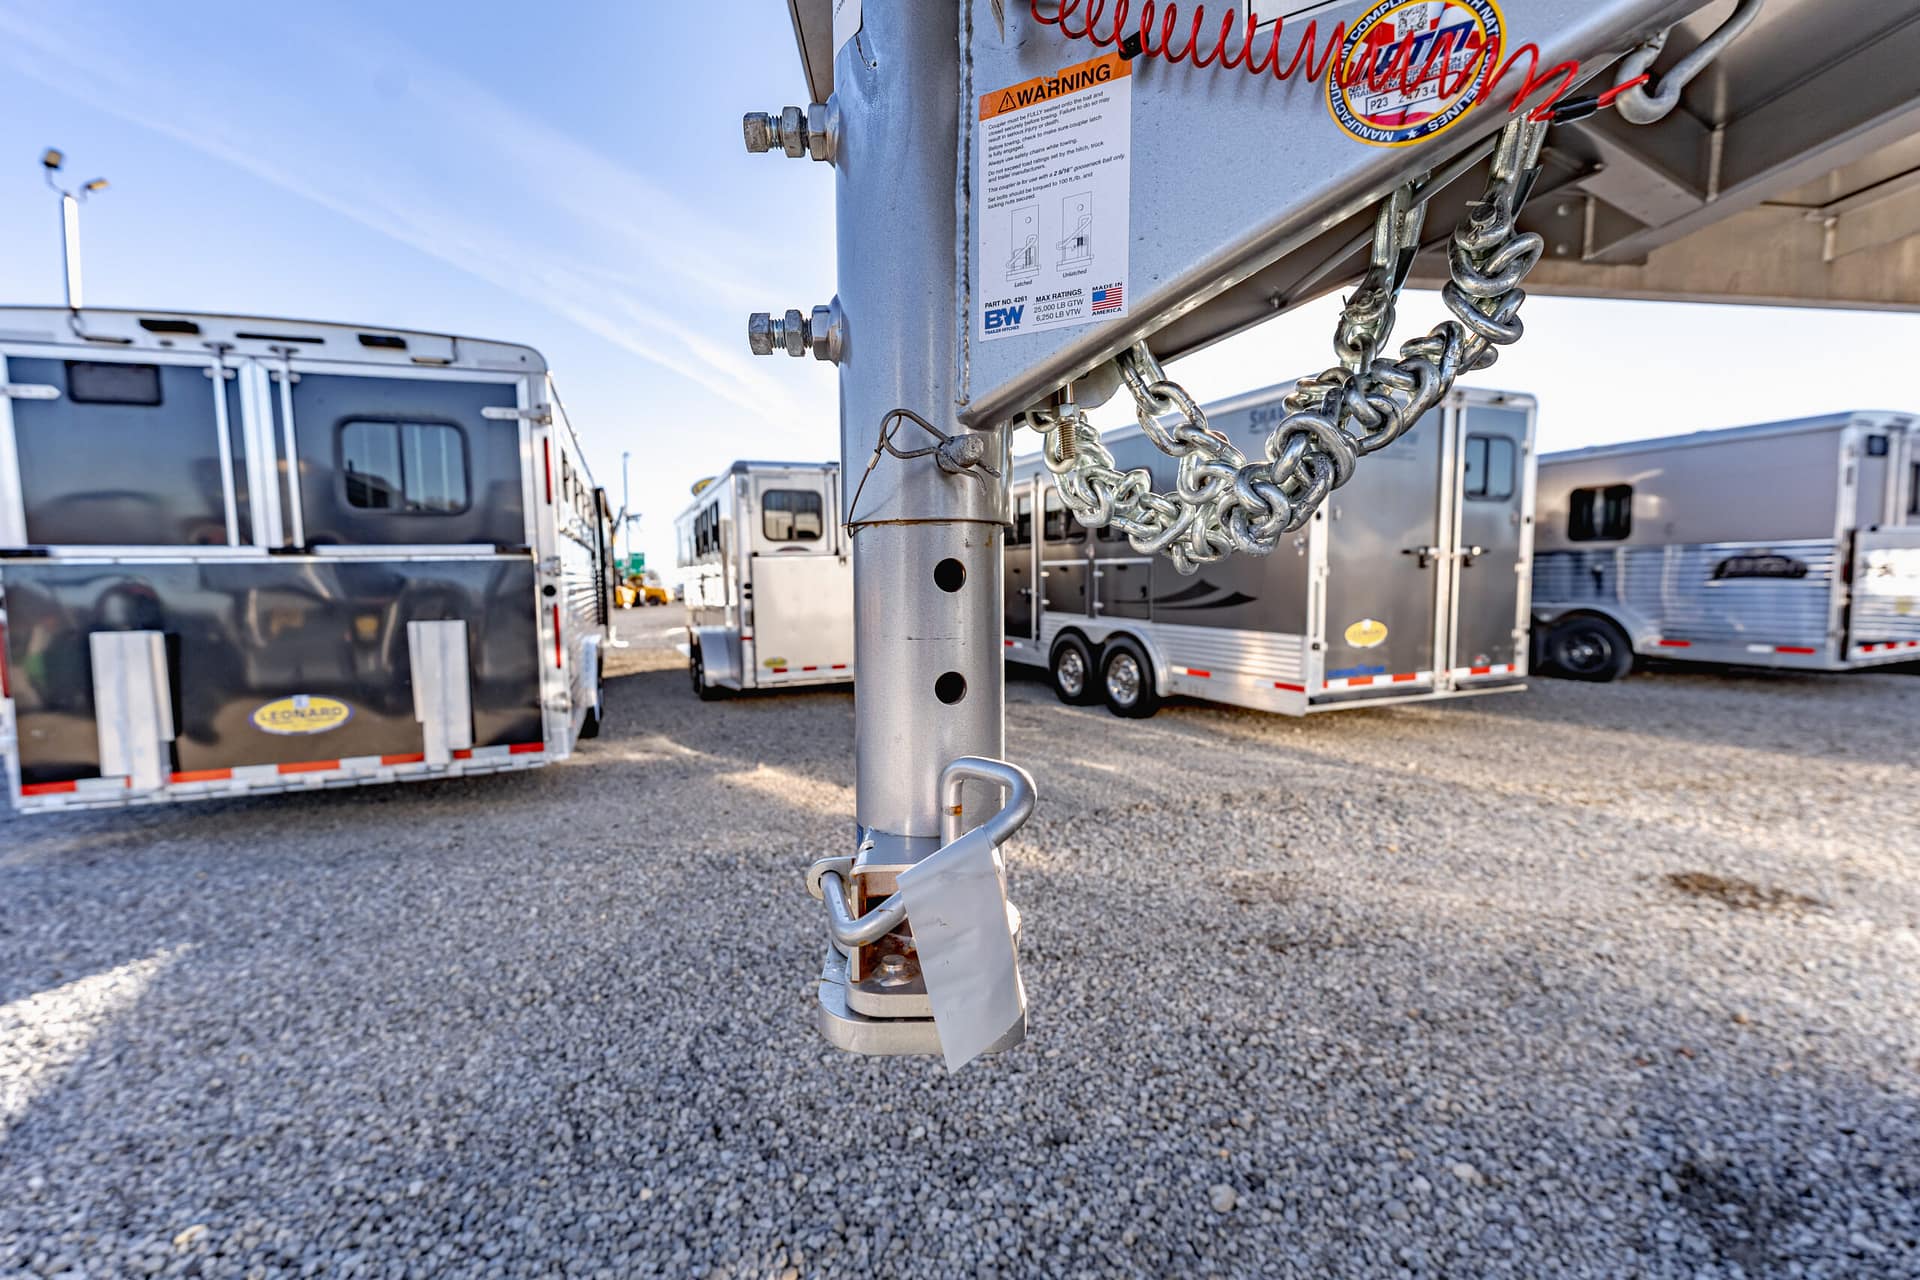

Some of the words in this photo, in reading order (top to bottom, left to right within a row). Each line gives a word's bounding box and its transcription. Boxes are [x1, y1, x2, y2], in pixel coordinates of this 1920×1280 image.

[1016, 63, 1112, 107] WARNING
[988, 121, 1006, 130] Coupler
[1026, 110, 1042, 119] FULLY
[1043, 104, 1060, 113] seated
[1061, 100, 1073, 108] onto
[1073, 97, 1082, 105] the
[1082, 94, 1092, 102] ball
[1093, 90, 1103, 98] and
[1370, 96, 1388, 110] P23
[988, 127, 1003, 136] closed
[1004, 122, 1024, 132] securely
[1024, 117, 1040, 127] before
[1059, 106, 1076, 116] Failure
[1083, 101, 1091, 109] do
[1091, 99, 1098, 107] so
[1098, 97, 1110, 105] may
[988, 143, 1004, 152] Before
[1022, 134, 1036, 142] check
[1042, 128, 1057, 136] make
[1058, 124, 1069, 132] sure
[1070, 118, 1089, 129] coupler
[1089, 114, 1102, 123] latch
[988, 135, 1001, 143] result
[1007, 129, 1024, 139] serious
[1024, 125, 1038, 134] injury
[988, 158, 1005, 167] Always
[1014, 151, 1029, 160] safety
[1029, 147, 1045, 156] chains
[1046, 143, 1060, 151] while
[993, 149, 1003, 157] fully
[1004, 162, 1021, 171] exceed
[1022, 159, 1032, 167] load
[1032, 155, 1049, 164] ratings
[1050, 152, 1058, 160] set
[1059, 151, 1065, 159] by
[1066, 148, 1075, 156] the
[1090, 140, 1103, 148] truck
[988, 174, 997, 183] and
[997, 171, 1010, 181] trailer
[998, 180, 1016, 191] coupler
[1038, 172, 1048, 181] with
[1073, 159, 1101, 173] gooseneck
[1102, 155, 1112, 164] ball
[1113, 152, 1125, 161] only
[987, 195, 996, 203] Set
[996, 192, 1008, 201] bolts
[1009, 188, 1025, 198] should
[1032, 181, 1052, 192] torqued
[1059, 177, 1069, 185] 100
[1083, 171, 1093, 179] and
[987, 200, 1005, 209] locking
[1005, 198, 1016, 206] nuts
[1062, 267, 1088, 279] Unlatched
[1014, 279, 1033, 289] Latched
[1092, 283, 1114, 292] MADE
[984, 300, 1001, 309] PART
[1001, 298, 1012, 306] NO.
[1013, 295, 1028, 304] 4261
[1035, 294, 1051, 303] MAX
[1051, 288, 1083, 299] RATINGS
[1033, 303, 1056, 314] 25,000
[1056, 301, 1066, 309] LB
[1066, 298, 1085, 308] GTW
[1091, 307, 1123, 317] AMERICA
[1035, 312, 1054, 322] 6,250
[1055, 310, 1065, 319] LB
[1065, 307, 1083, 317] VTW
[1001, 325, 1020, 333] HITCHES
